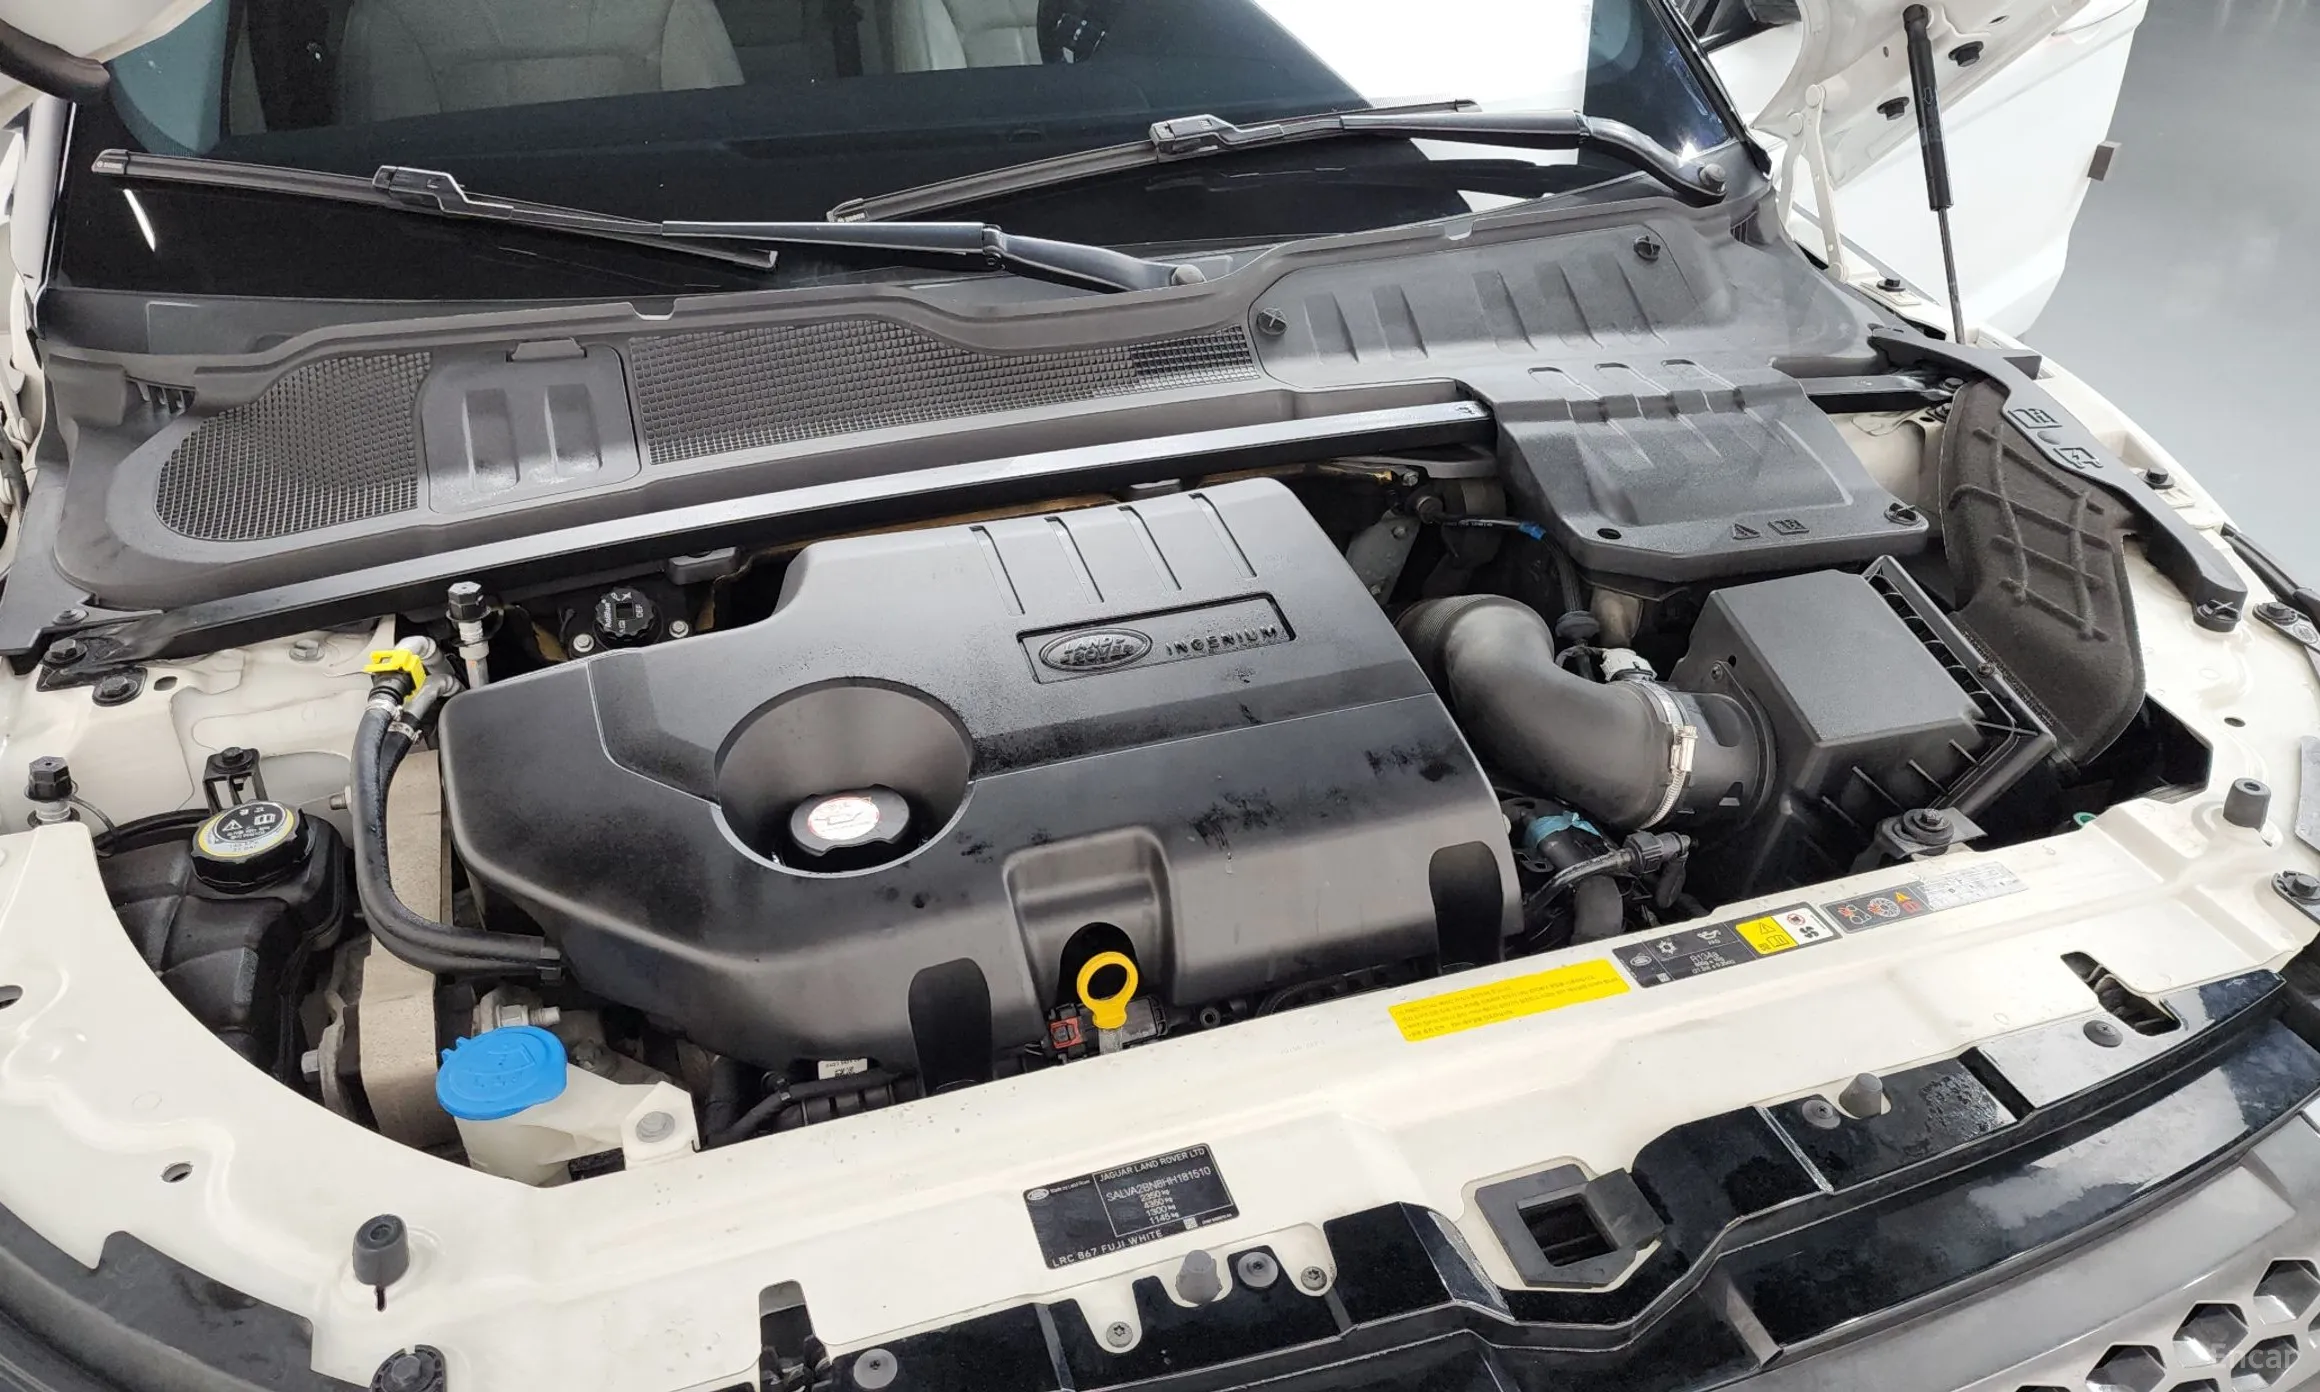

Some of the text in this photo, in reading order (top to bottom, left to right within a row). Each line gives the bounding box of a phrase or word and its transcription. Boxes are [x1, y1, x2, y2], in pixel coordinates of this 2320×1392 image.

[1165, 625, 1278, 656] INGENIUM
[1100, 1147, 1205, 1182] JAGUAR LAND ROVER LTD
[1146, 1205, 1168, 1217] 1300
[1052, 1229, 1163, 1268] LRC 867 FUJI WHITE
